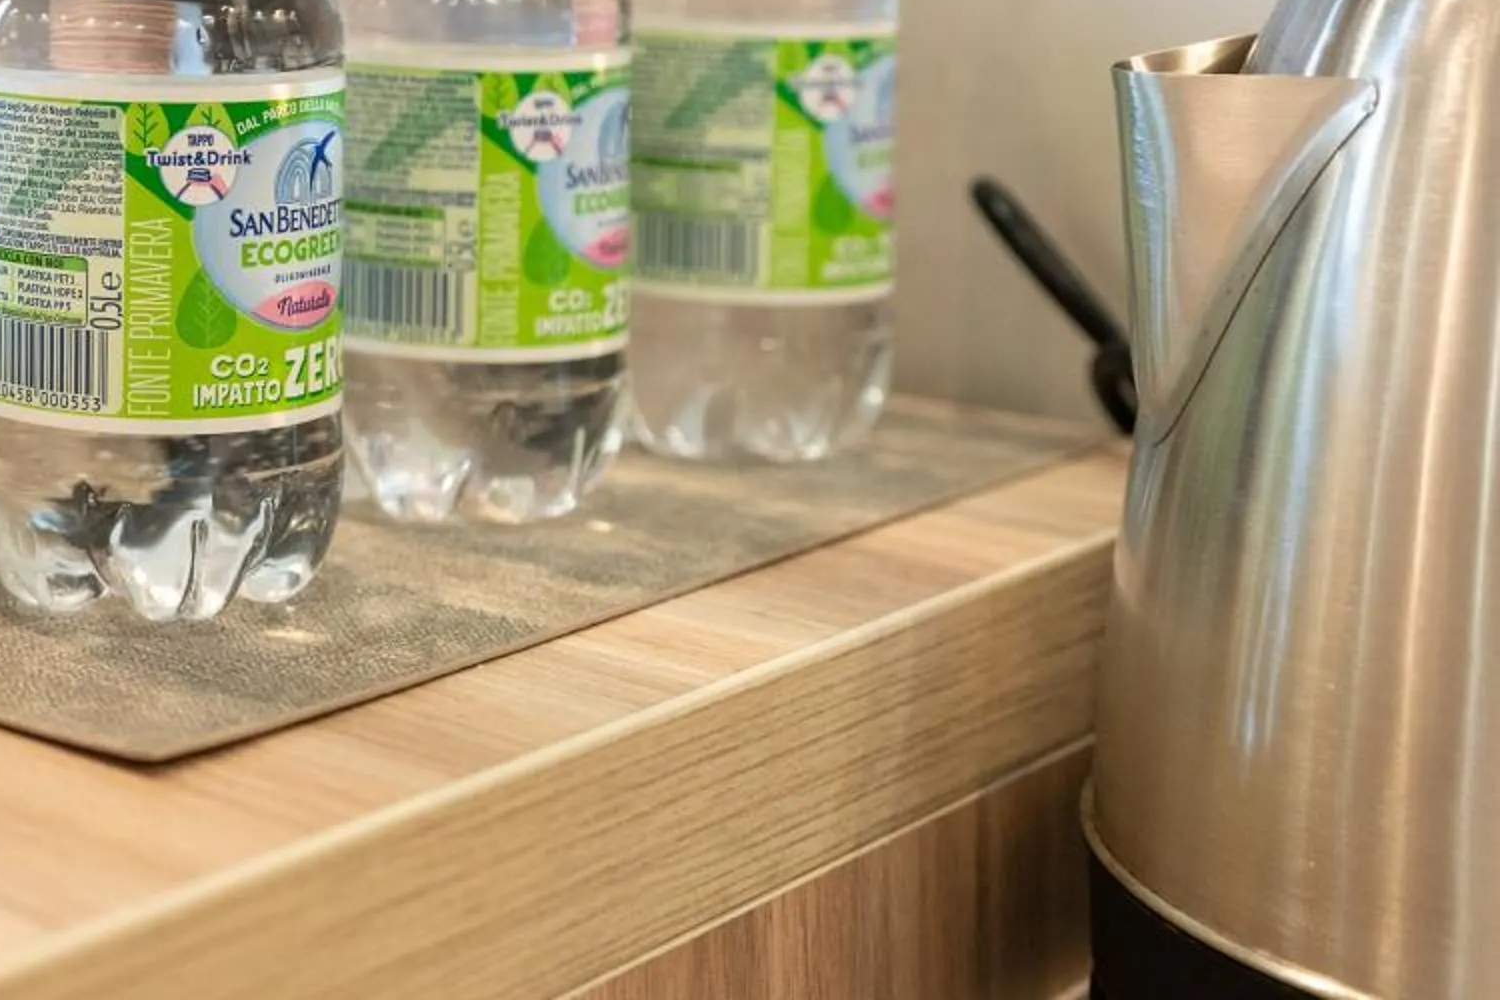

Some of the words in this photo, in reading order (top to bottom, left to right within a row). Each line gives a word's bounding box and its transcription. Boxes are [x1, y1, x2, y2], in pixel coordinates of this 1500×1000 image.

[236, 117, 261, 136] DAL
[147, 149, 252, 167] Twist&Drink
[277, 199, 341, 234] BENEDET
[129, 217, 173, 341] PRIMAVERA
[128, 347, 172, 416] FONTE
[193, 378, 282, 408] IMPATTO
[41, 391, 101, 412] 000553
